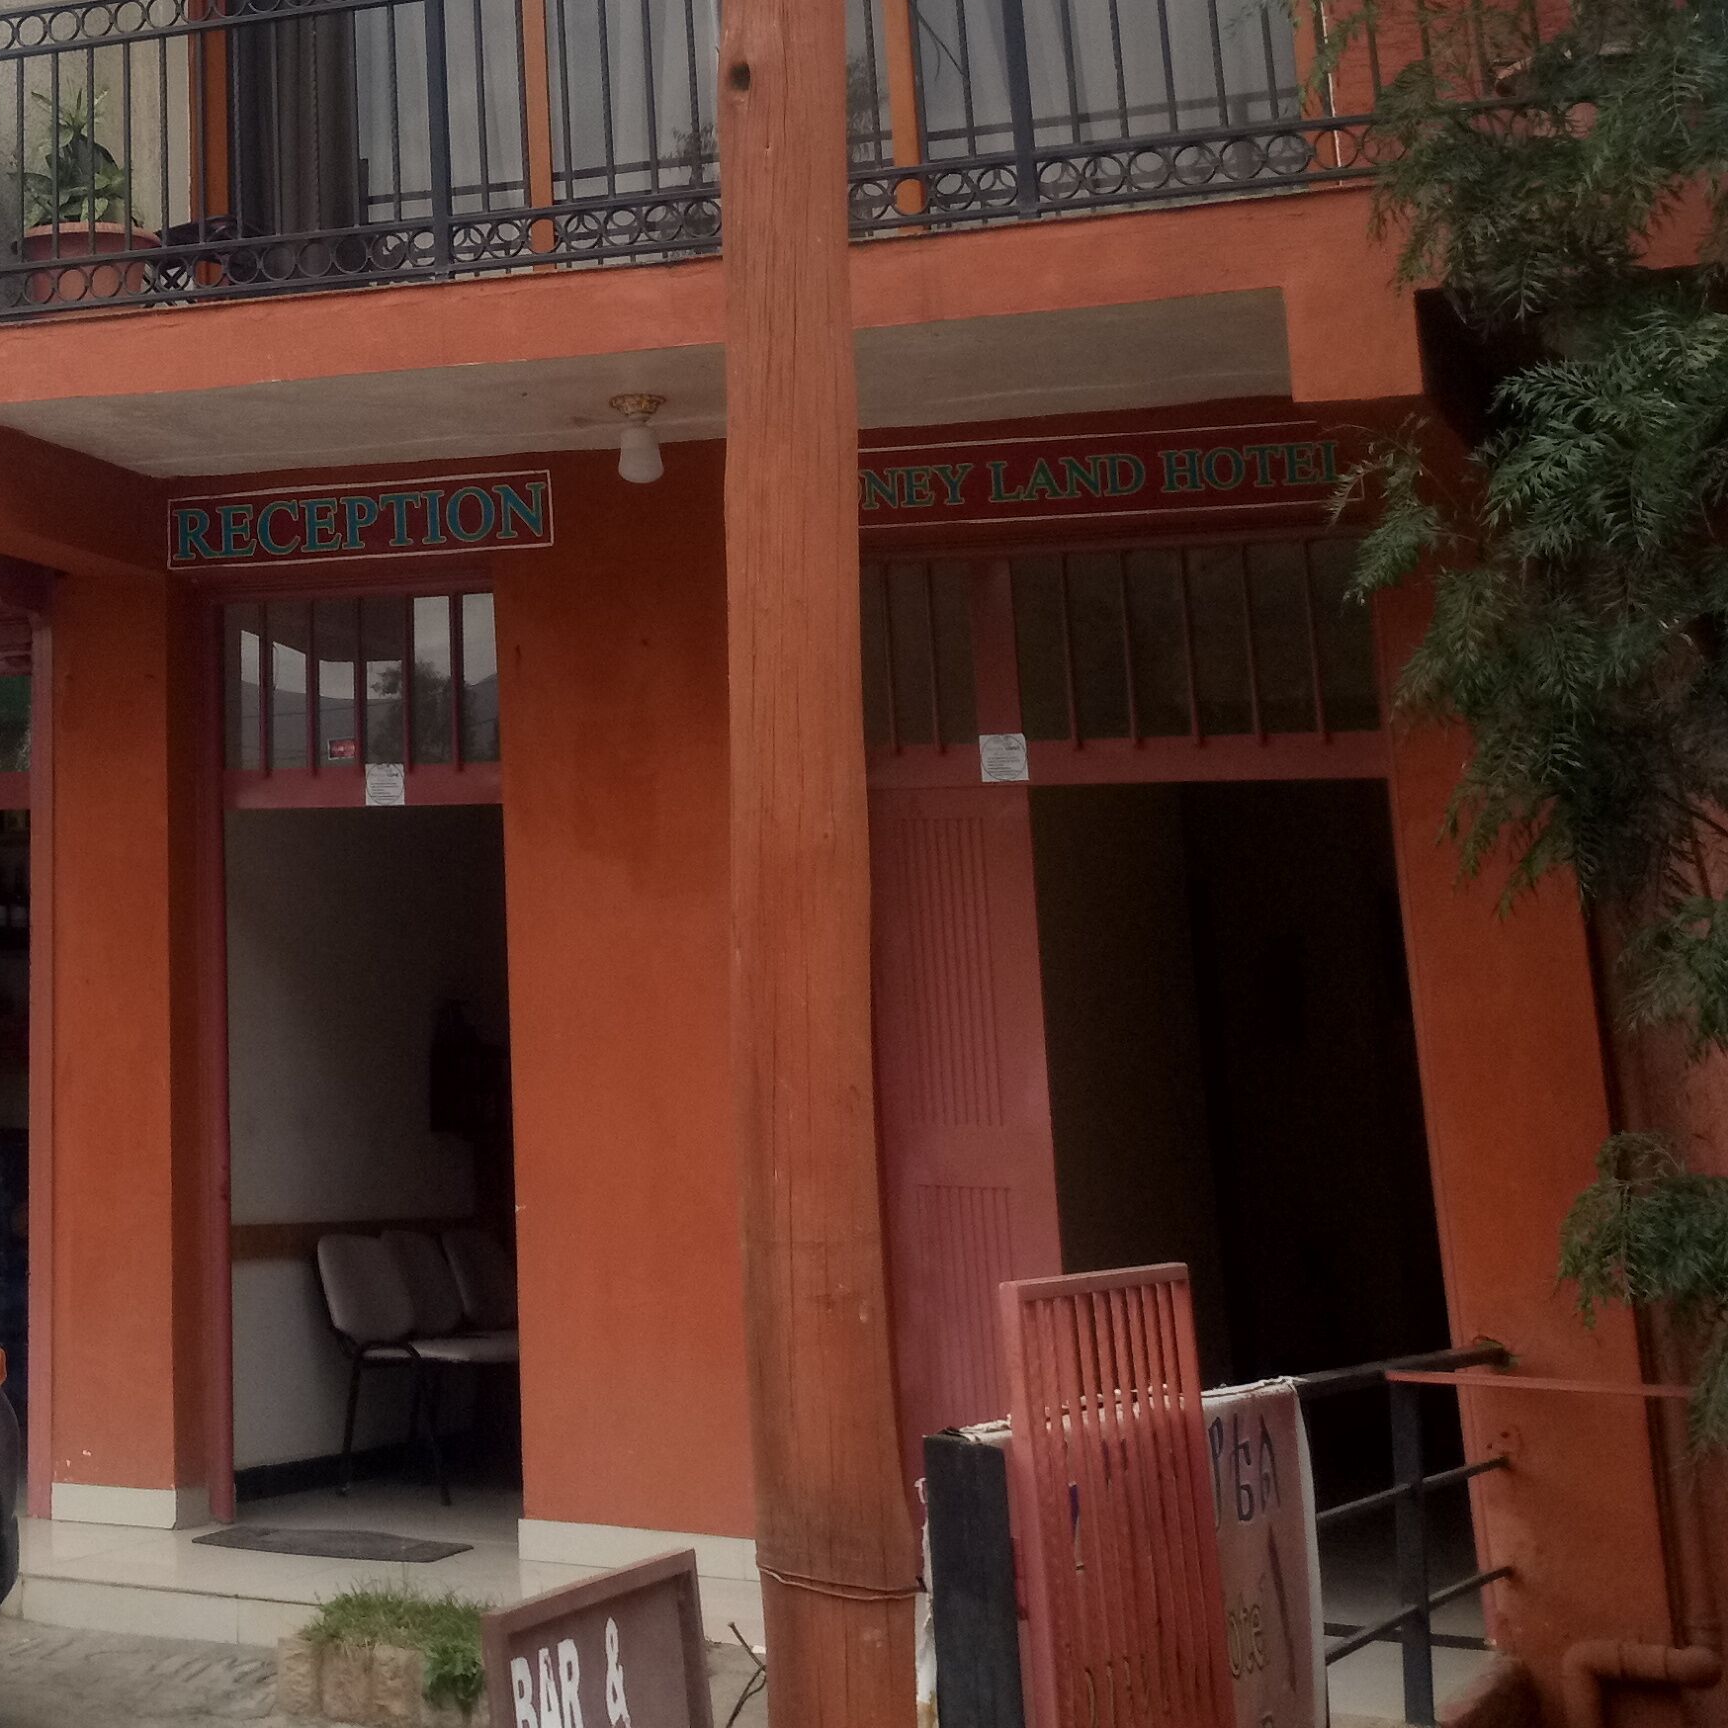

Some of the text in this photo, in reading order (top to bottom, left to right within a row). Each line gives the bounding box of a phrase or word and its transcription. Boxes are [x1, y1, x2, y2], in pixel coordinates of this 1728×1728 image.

[858, 440, 1342, 510] NEY LAND HOTEL
[172, 482, 547, 561] RECEPTION
